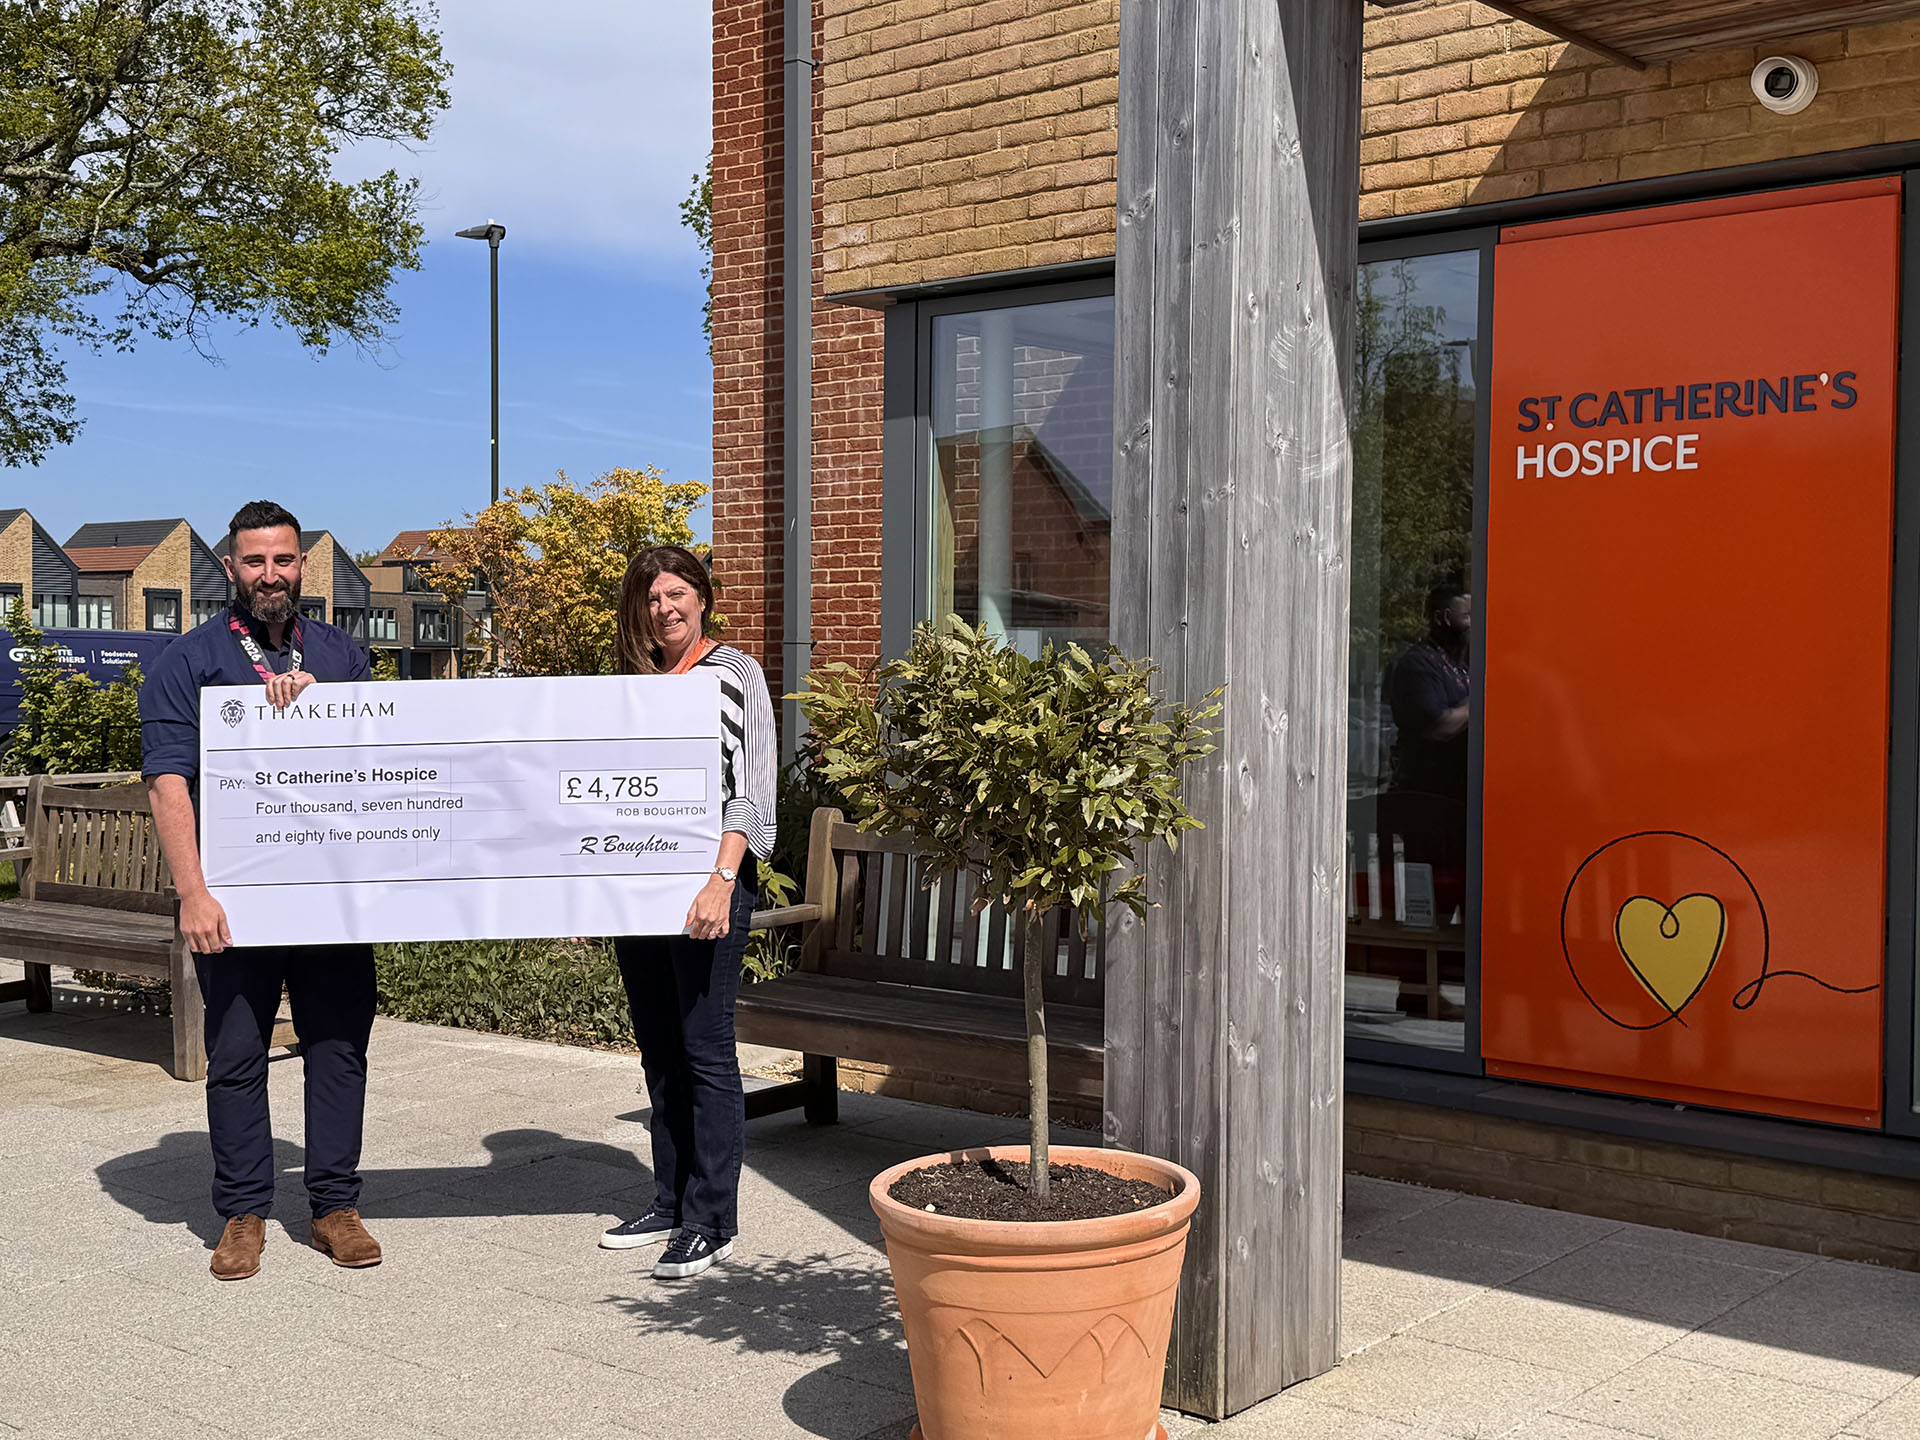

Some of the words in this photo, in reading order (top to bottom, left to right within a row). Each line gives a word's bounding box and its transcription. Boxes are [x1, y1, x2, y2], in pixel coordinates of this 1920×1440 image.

[1568, 371, 1858, 428] CATHERINE'S
[1516, 434, 1699, 480] HOSPICE
[100, 650, 138, 658] Foodservice
[240, 636, 262, 662] 2026
[254, 701, 395, 721] THAKEHAM
[219, 779, 246, 790] PAY:
[255, 771, 272, 785] St
[277, 769, 367, 785] Catherine's
[372, 768, 438, 784] Hospice
[588, 776, 659, 801] 4,785
[255, 802, 286, 815] Four
[290, 800, 357, 814] thousand,
[361, 800, 403, 812] seven
[407, 797, 464, 810] hundred
[616, 808, 640, 817] ROB
[644, 806, 707, 816] BOUGHTON
[255, 830, 281, 843] and
[285, 829, 325, 845] eighty
[329, 828, 352, 841] five
[356, 827, 408, 843] pounds
[412, 826, 441, 841] only
[579, 836, 599, 855] R
[603, 834, 680, 858] Boughton
